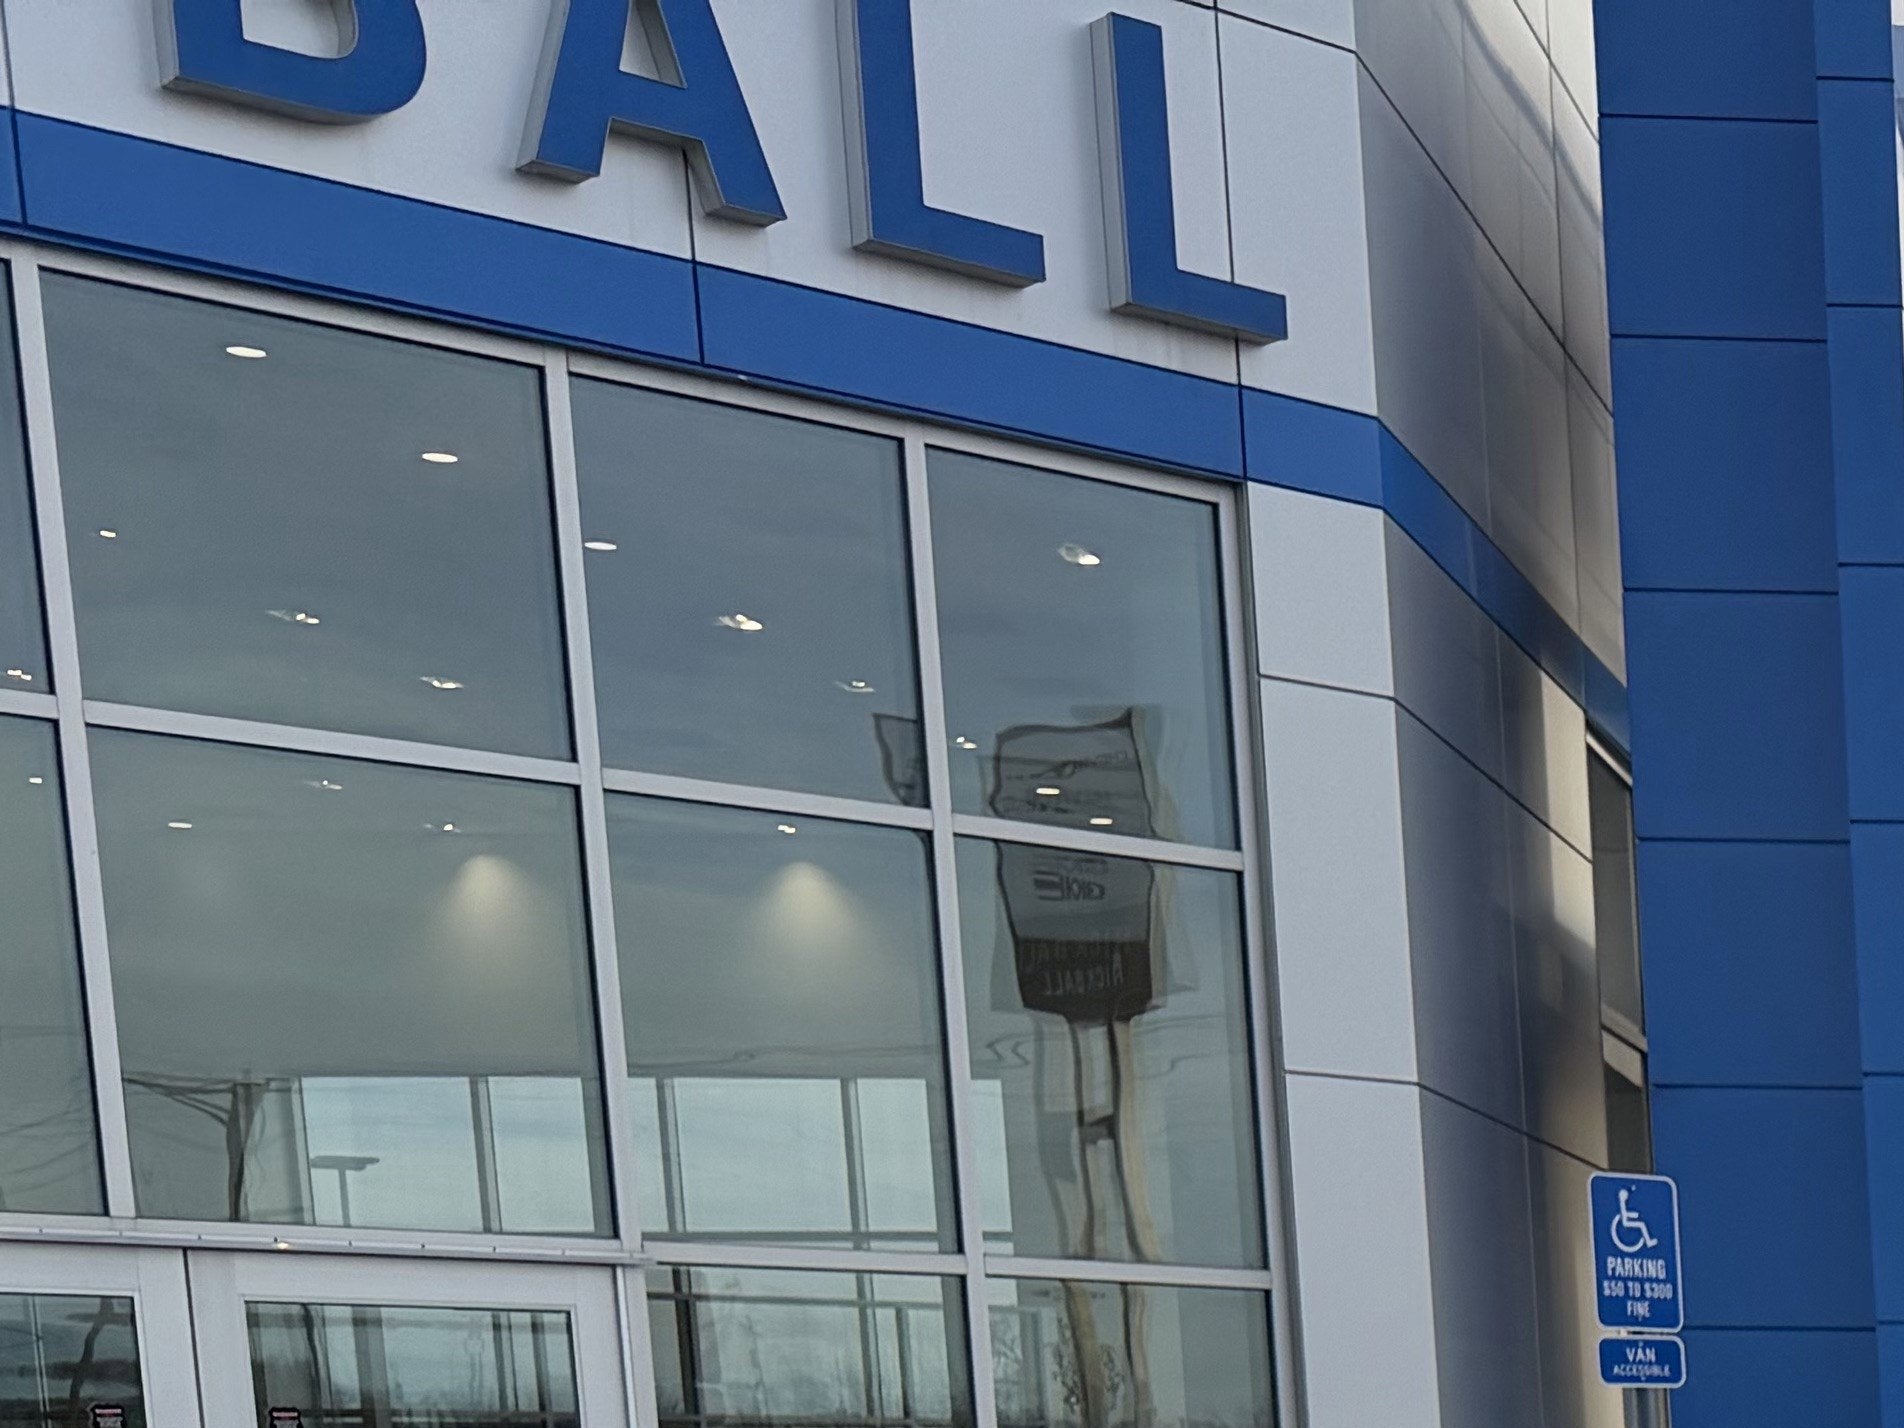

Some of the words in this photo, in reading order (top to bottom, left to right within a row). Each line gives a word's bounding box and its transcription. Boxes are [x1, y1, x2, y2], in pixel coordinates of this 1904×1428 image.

[1607, 1256, 1666, 1280] PARKING
[1627, 1281, 1642, 1298] TO
[1626, 1300, 1650, 1318] FINE
[1625, 1347, 1656, 1363] VAN
